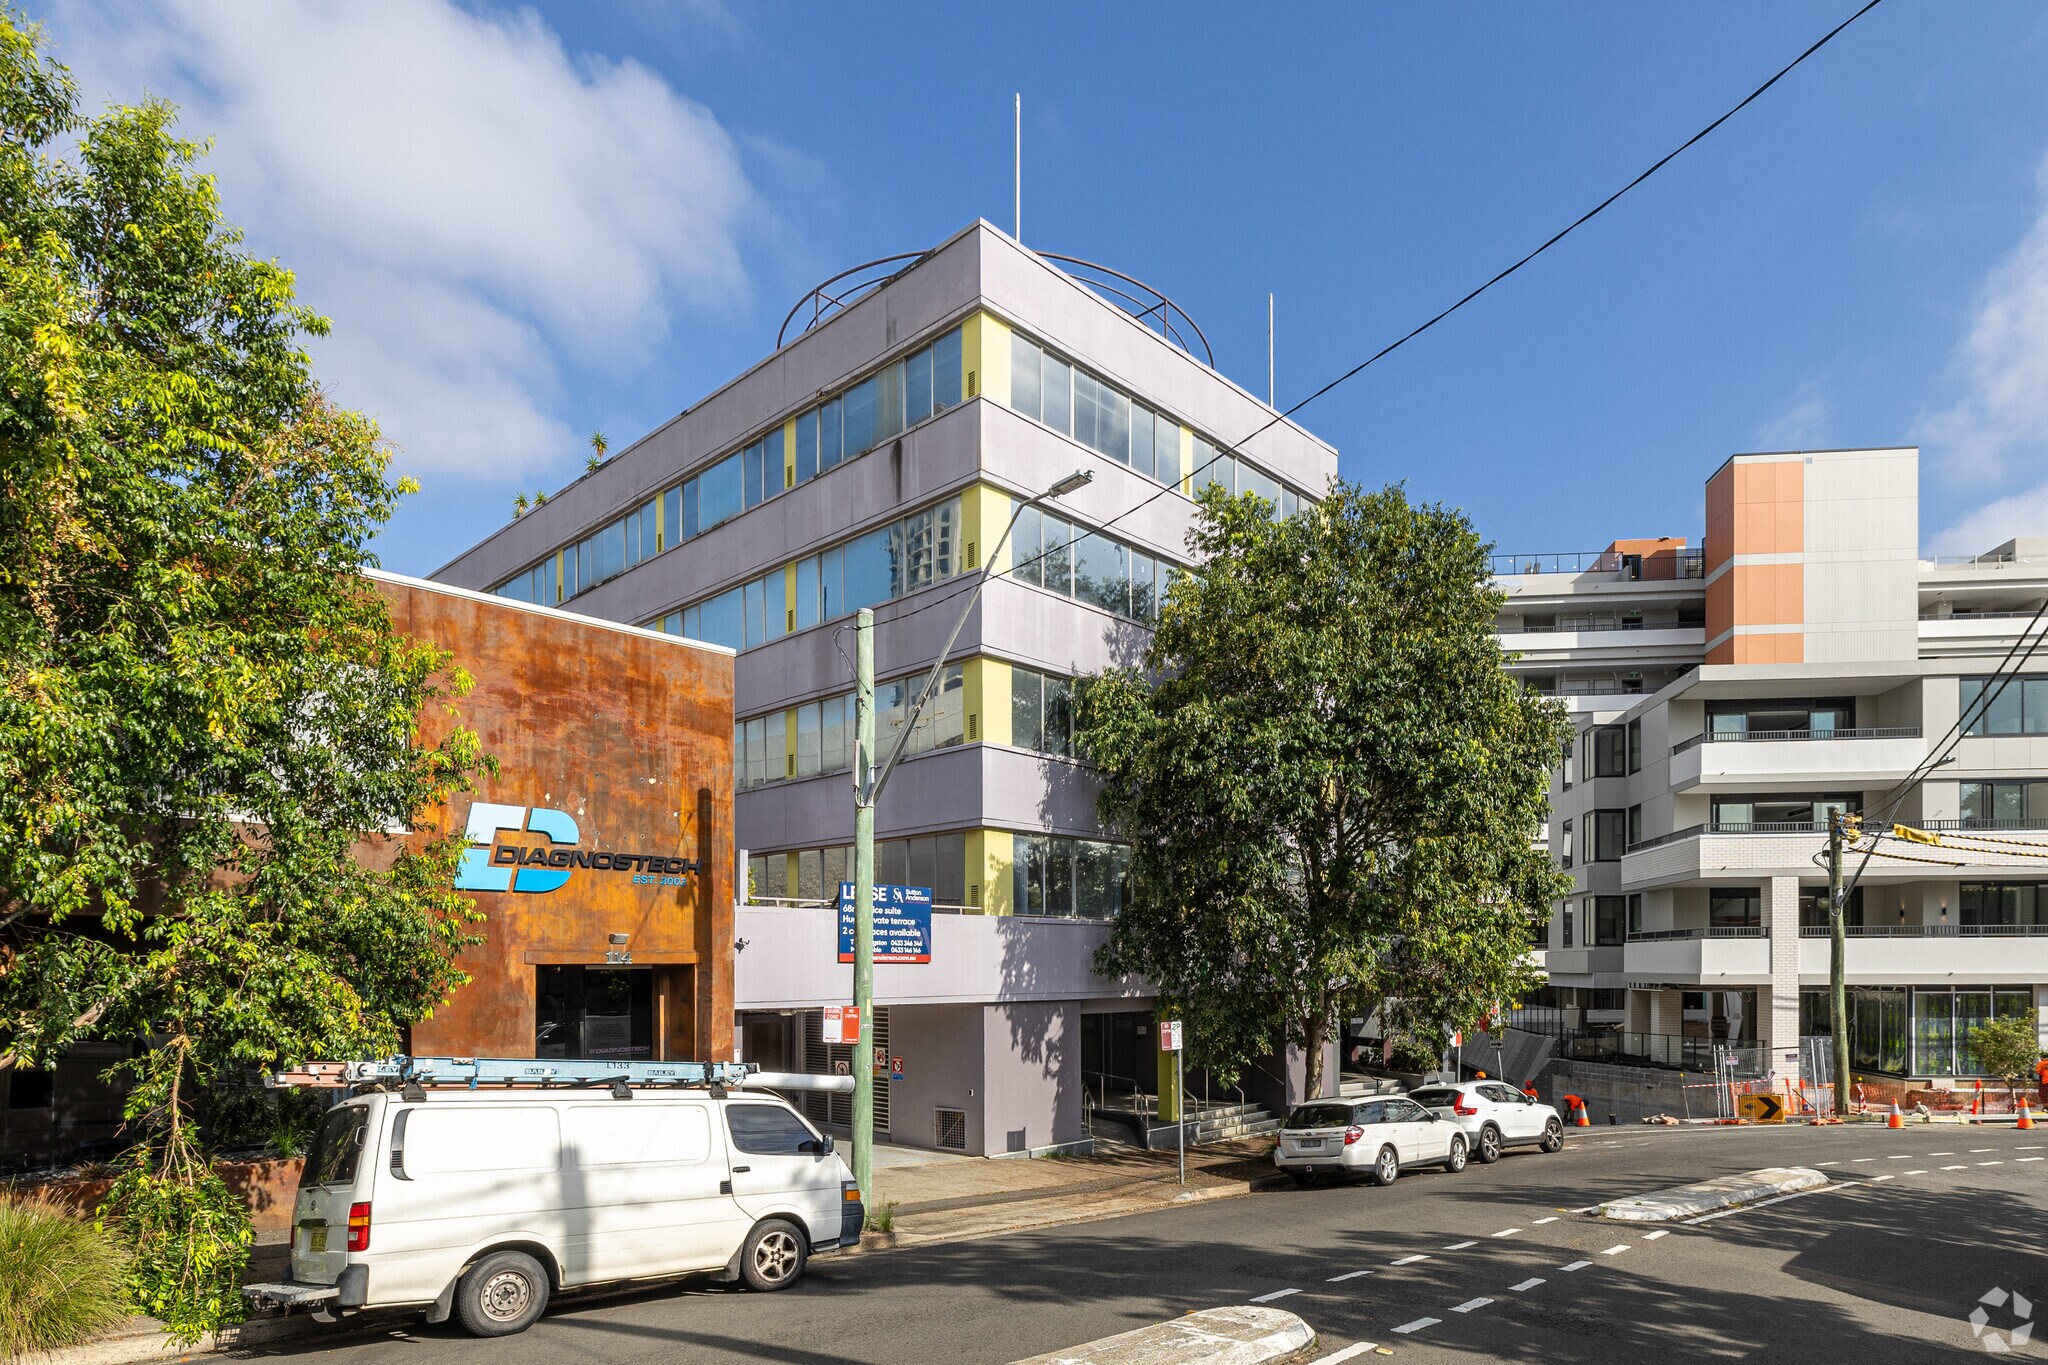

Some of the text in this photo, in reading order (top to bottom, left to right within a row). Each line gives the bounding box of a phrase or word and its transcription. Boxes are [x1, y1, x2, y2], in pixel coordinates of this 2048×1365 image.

[494, 845, 701, 875] DIAGNOSTECH
[632, 875, 687, 886] EST. 2002
[842, 884, 887, 902] LESE
[842, 927, 848, 935] 2
[889, 929, 921, 937] available
[605, 951, 632, 964] 114
[595, 1045, 650, 1055] DIAGNOSTECH
